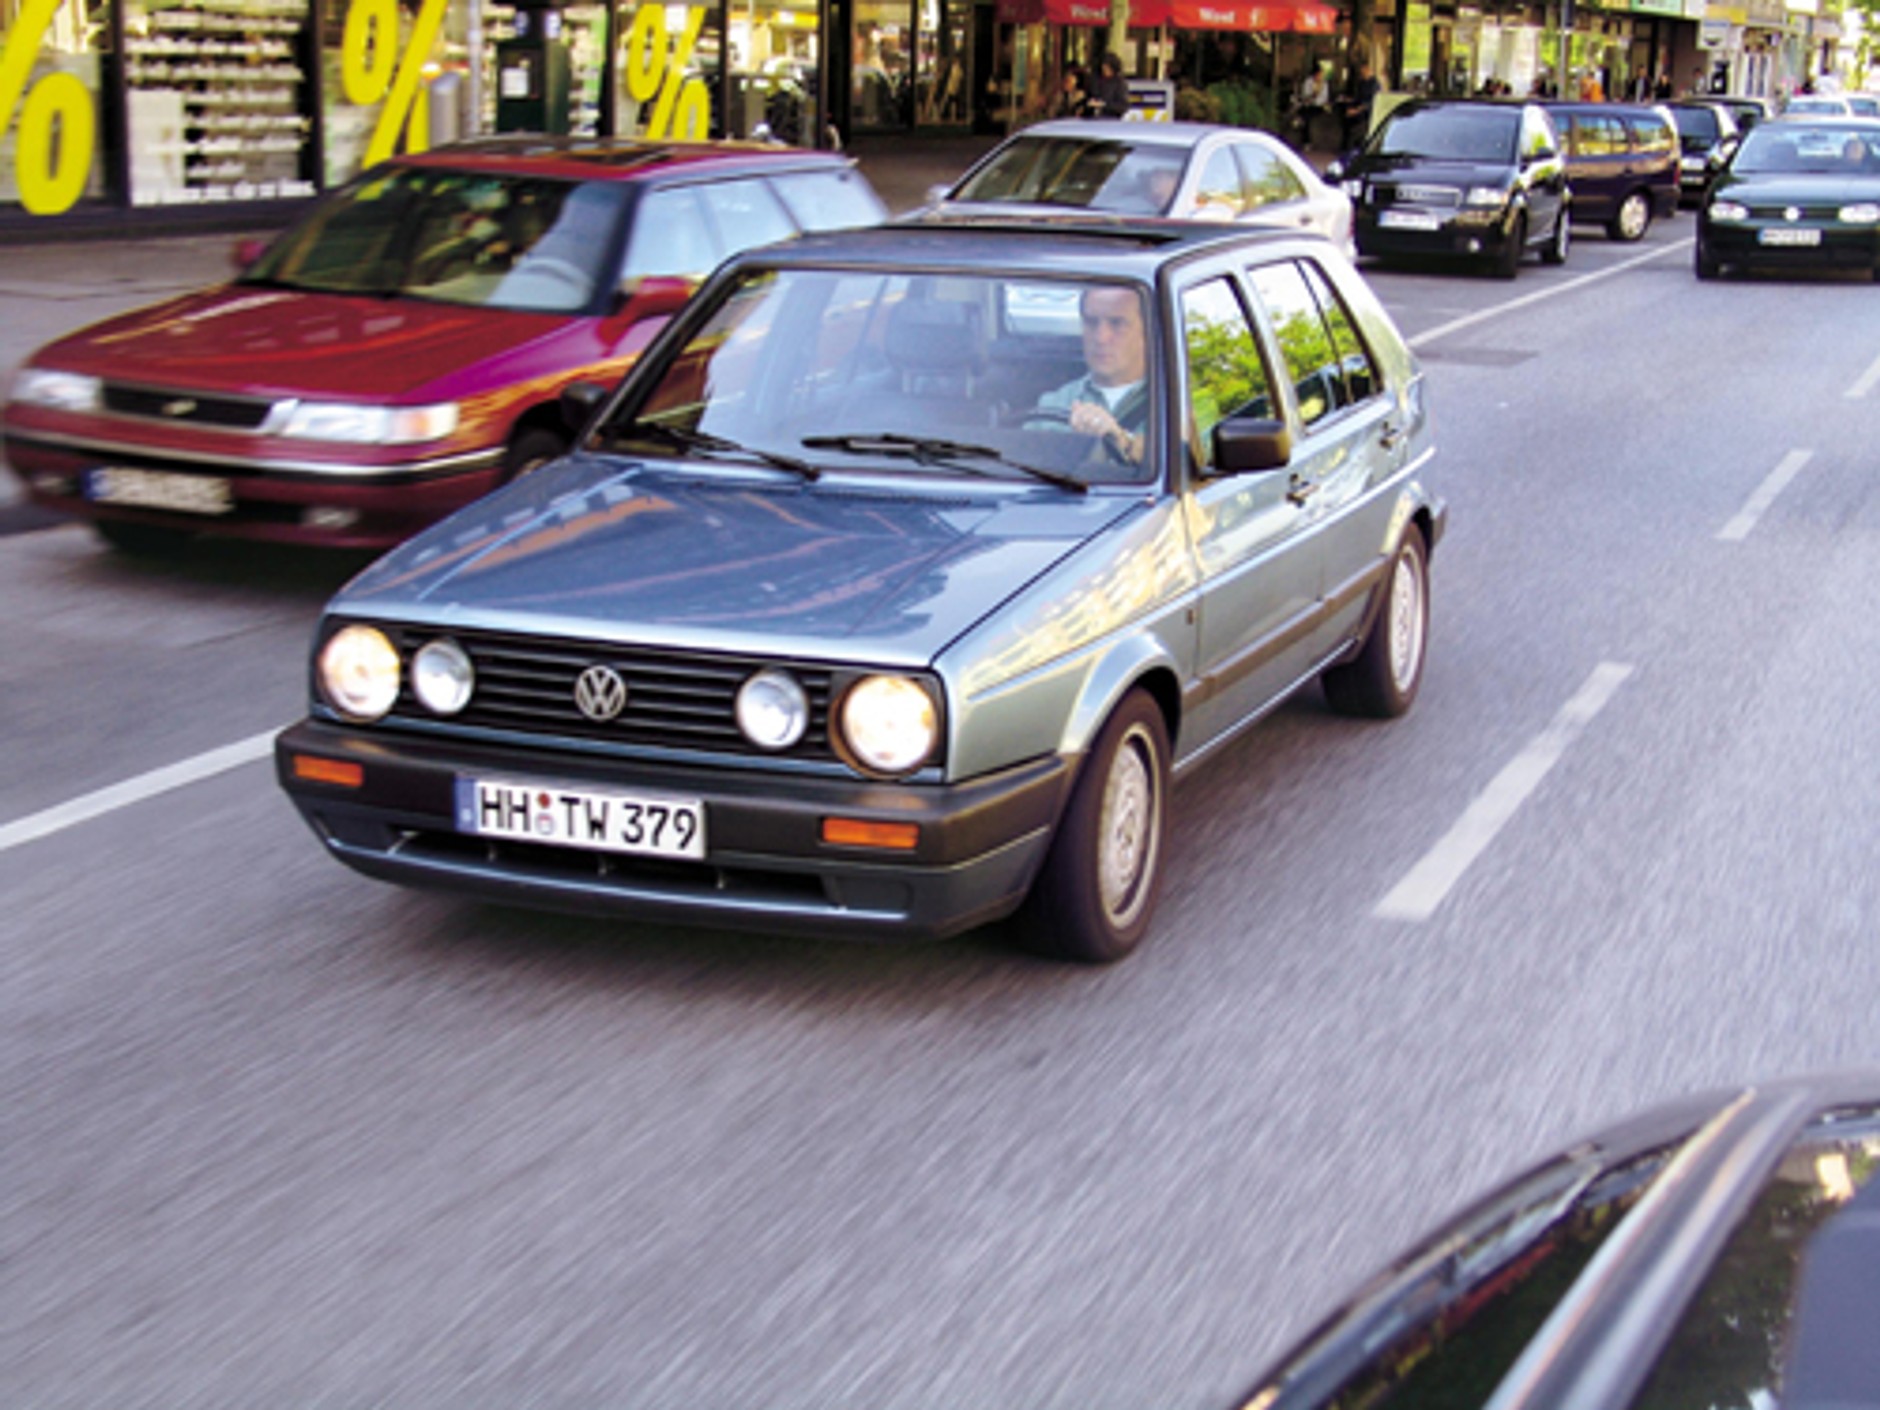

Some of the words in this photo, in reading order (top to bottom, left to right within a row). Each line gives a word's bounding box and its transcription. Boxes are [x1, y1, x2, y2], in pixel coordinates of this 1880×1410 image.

[480, 785, 531, 832] HH
[559, 796, 610, 840] TW
[622, 803, 697, 850] 379
